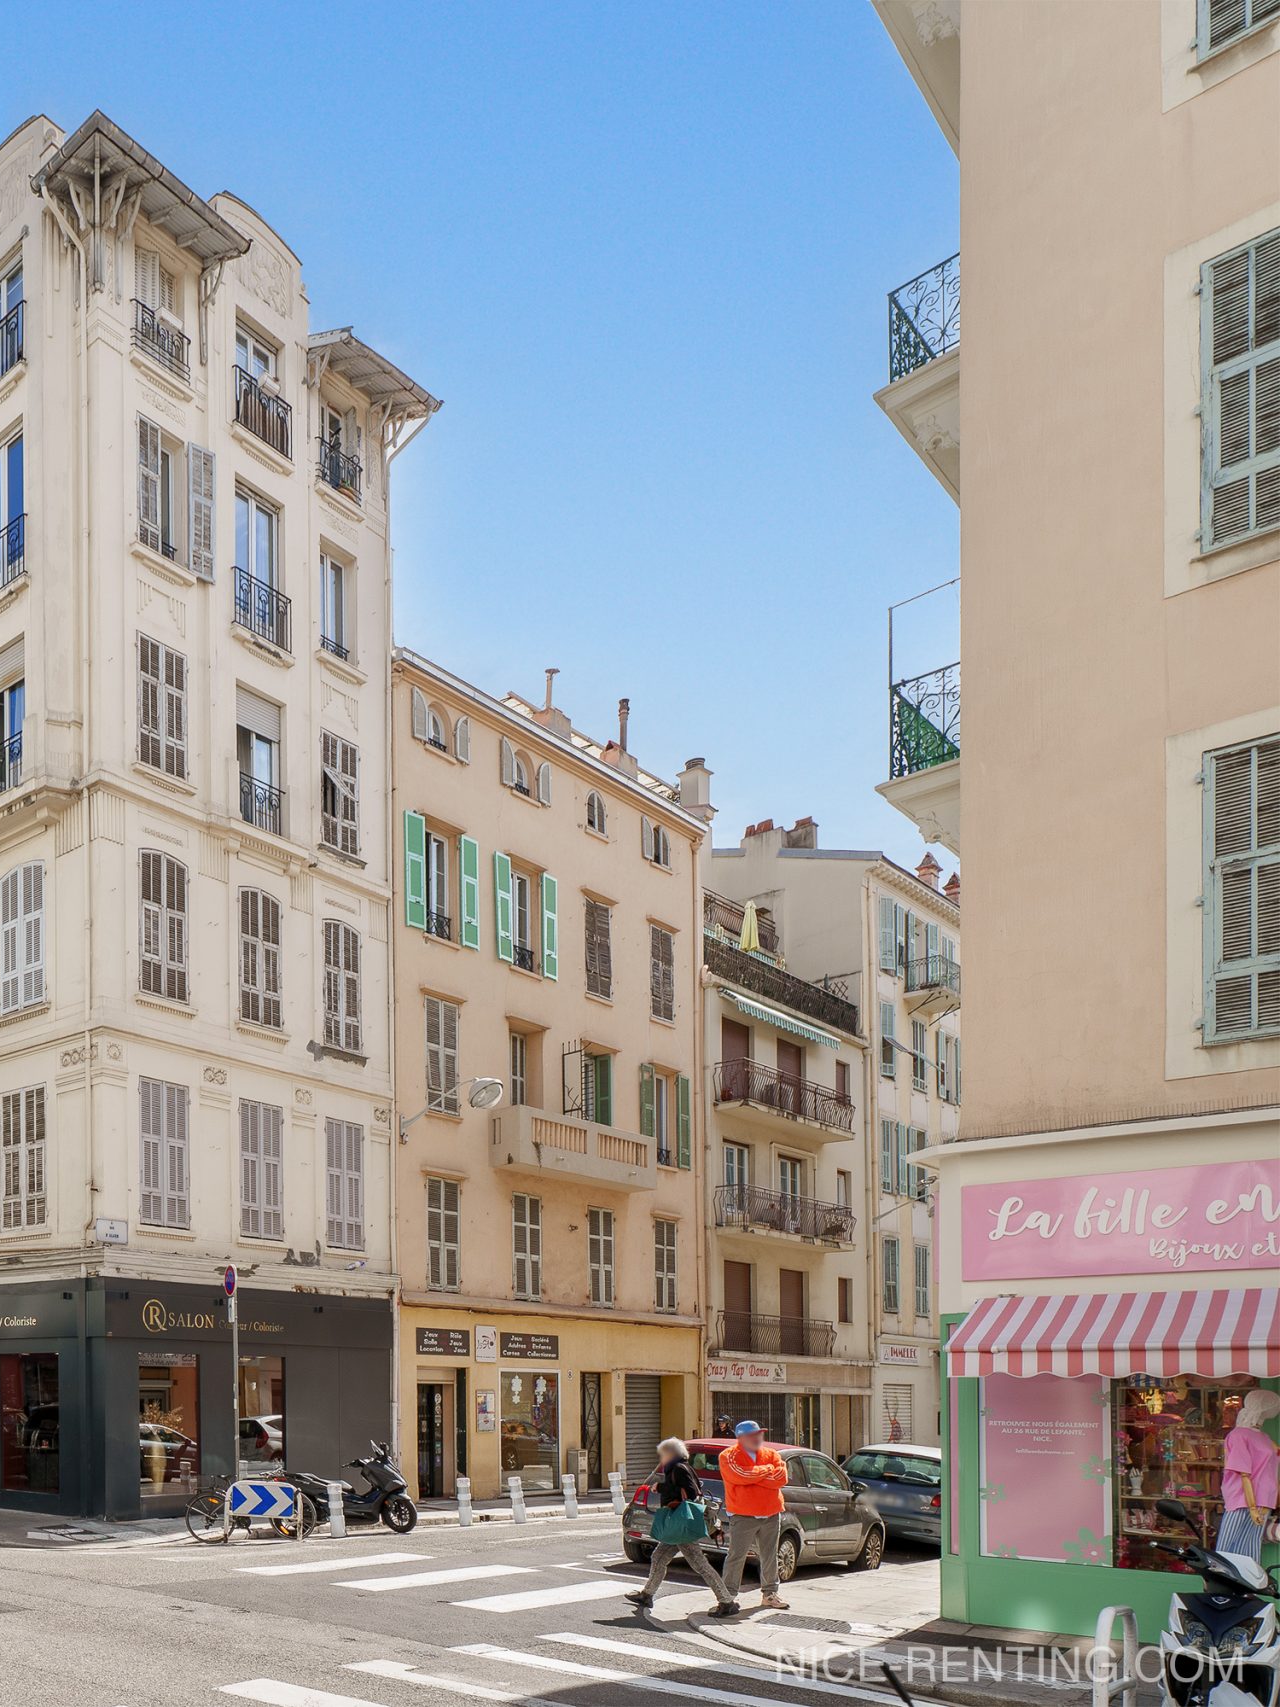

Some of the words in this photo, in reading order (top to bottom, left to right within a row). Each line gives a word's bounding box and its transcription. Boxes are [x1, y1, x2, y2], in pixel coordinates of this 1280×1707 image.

[988, 1197, 1064, 1241] La
[1074, 1187, 1188, 1239] fille
[1206, 1184, 1280, 1225] en
[1149, 1238, 1246, 1268] Bijoux
[1251, 1232, 1280, 1256] et
[4, 1315, 37, 1327] Coloriste
[168, 1312, 215, 1329] SALON
[253, 1321, 285, 1333] Coloriste
[706, 1362, 727, 1380] Crazy
